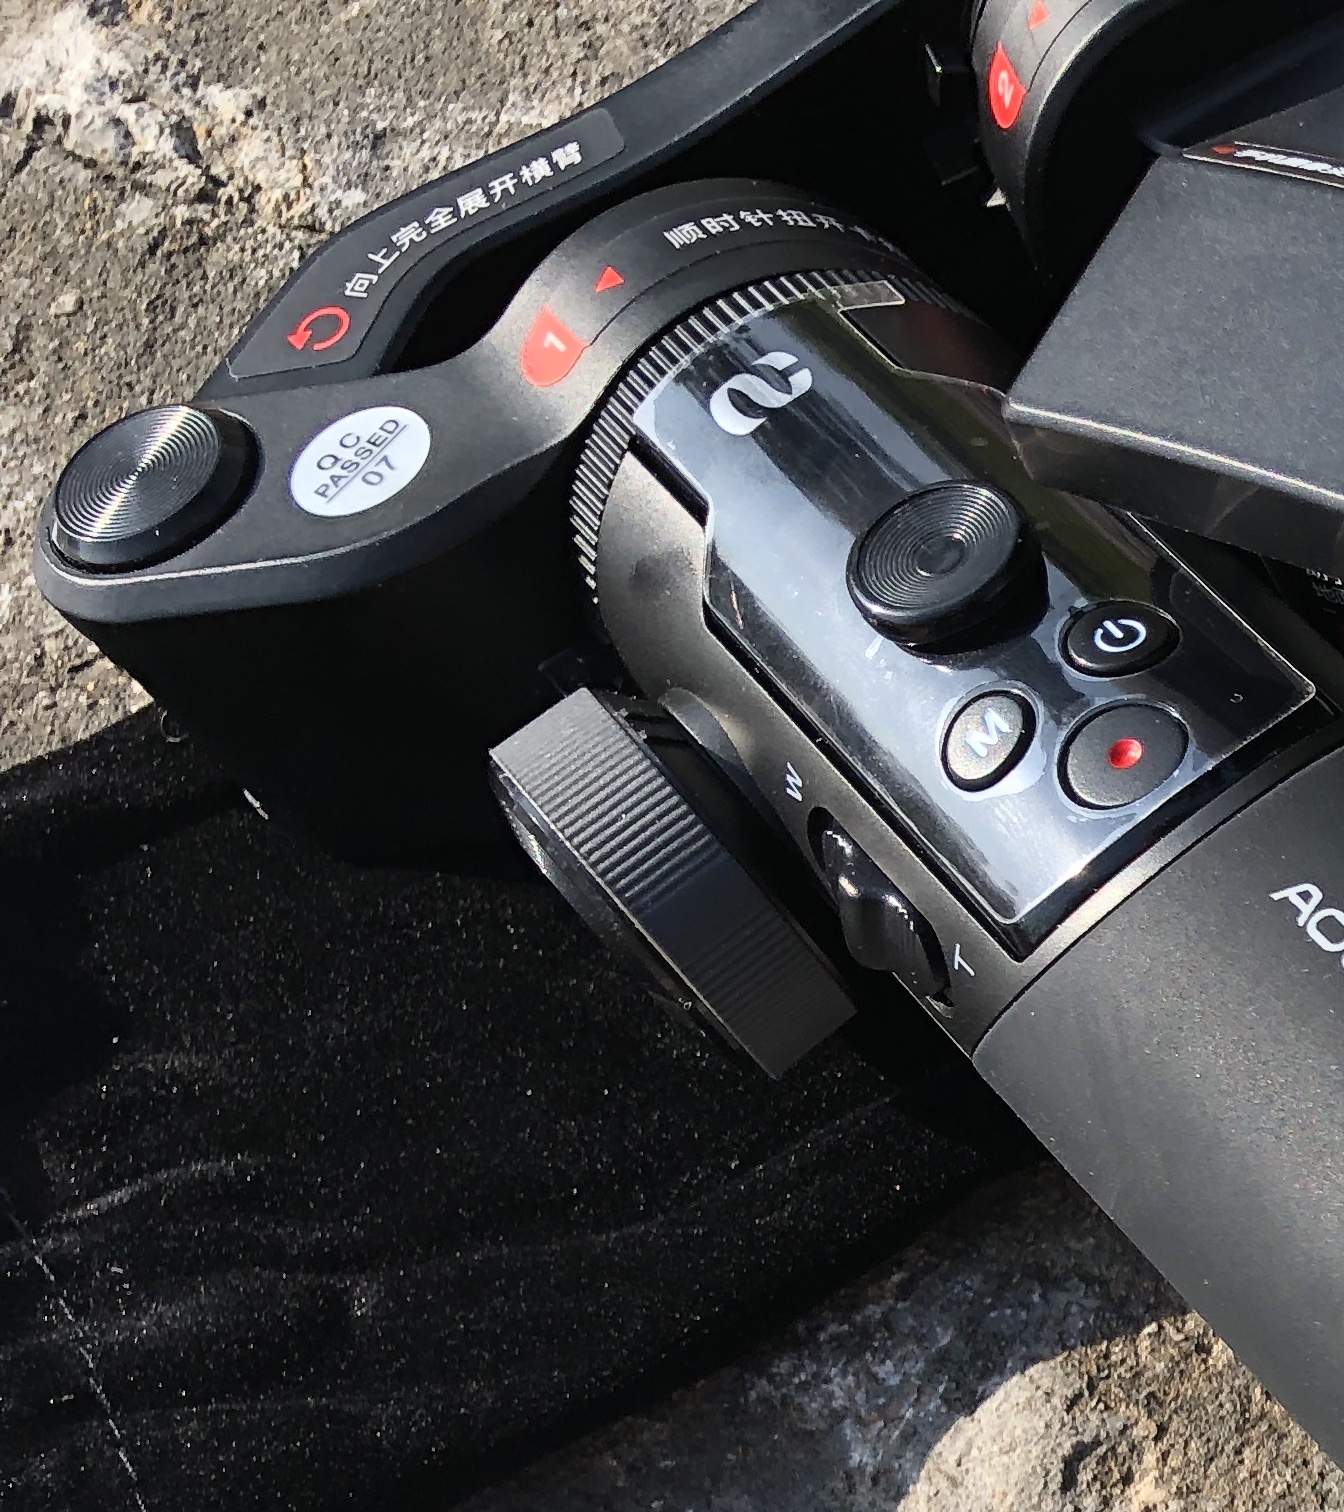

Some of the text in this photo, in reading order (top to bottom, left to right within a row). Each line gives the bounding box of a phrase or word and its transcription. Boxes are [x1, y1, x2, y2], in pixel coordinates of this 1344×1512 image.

[997, 70, 1015, 109] 2
[344, 141, 584, 299] 向上完全展开横臂
[543, 331, 567, 353] 1
[313, 419, 400, 499] PASSED
[361, 454, 397, 486] 07
